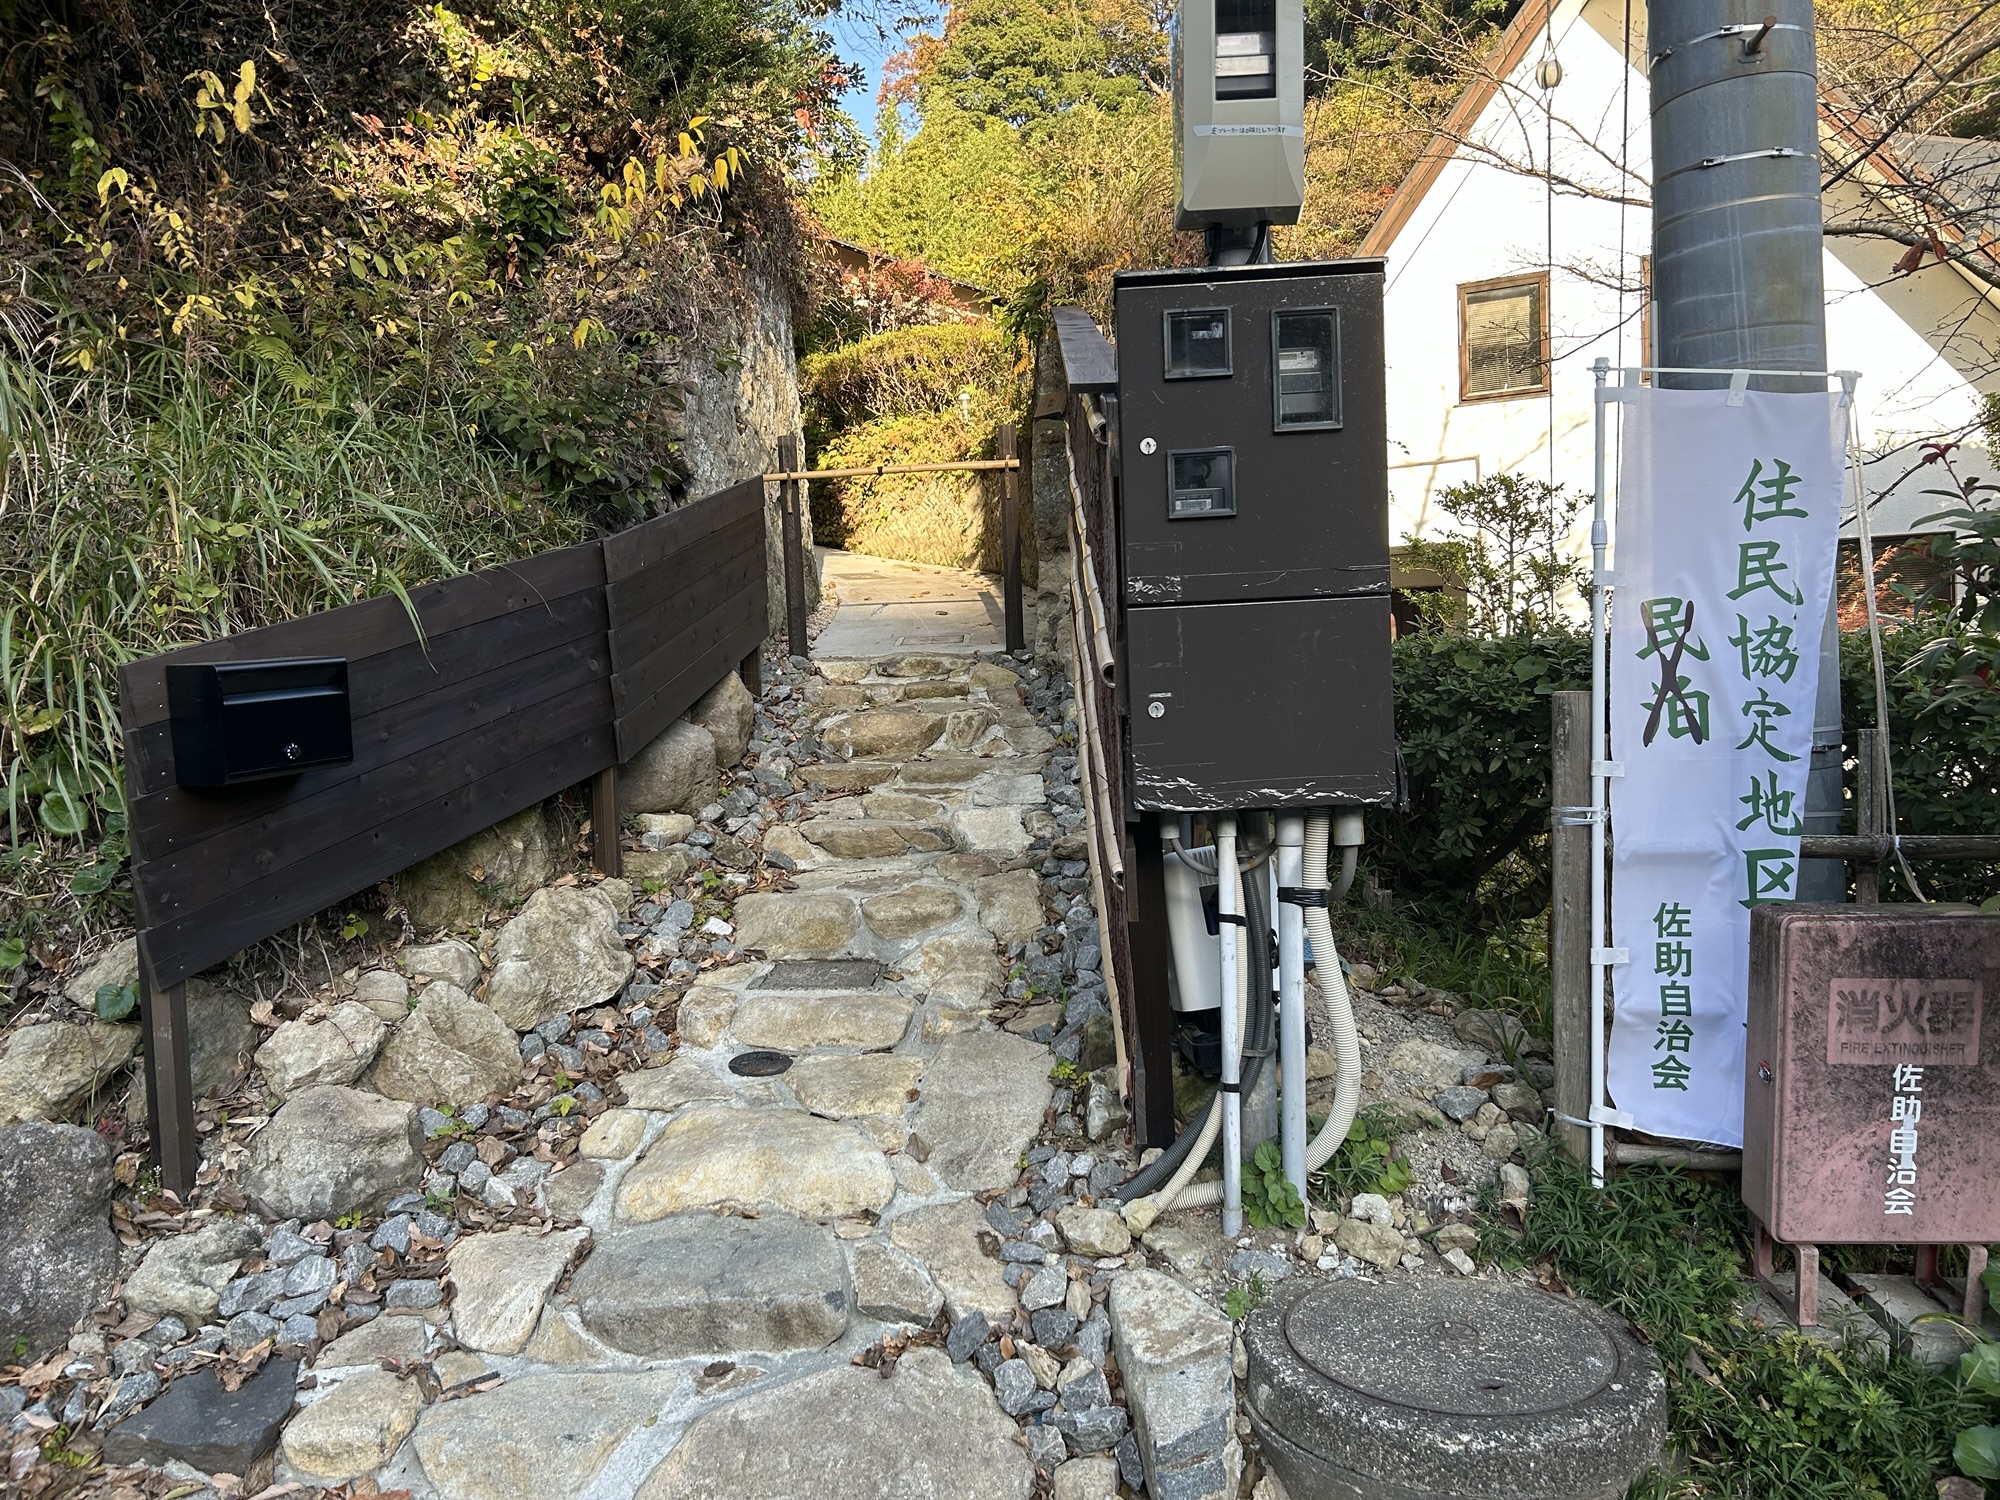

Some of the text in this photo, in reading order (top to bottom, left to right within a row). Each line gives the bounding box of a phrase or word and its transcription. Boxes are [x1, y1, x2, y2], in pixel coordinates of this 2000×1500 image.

[1726, 457, 1809, 910] 住民協定地区
[1651, 901, 1694, 1092] 佐助自治会
[1840, 1042, 1965, 1056] FIRE EXTINGUISHER
[1884, 1062, 1924, 1216] 佐助自治会
